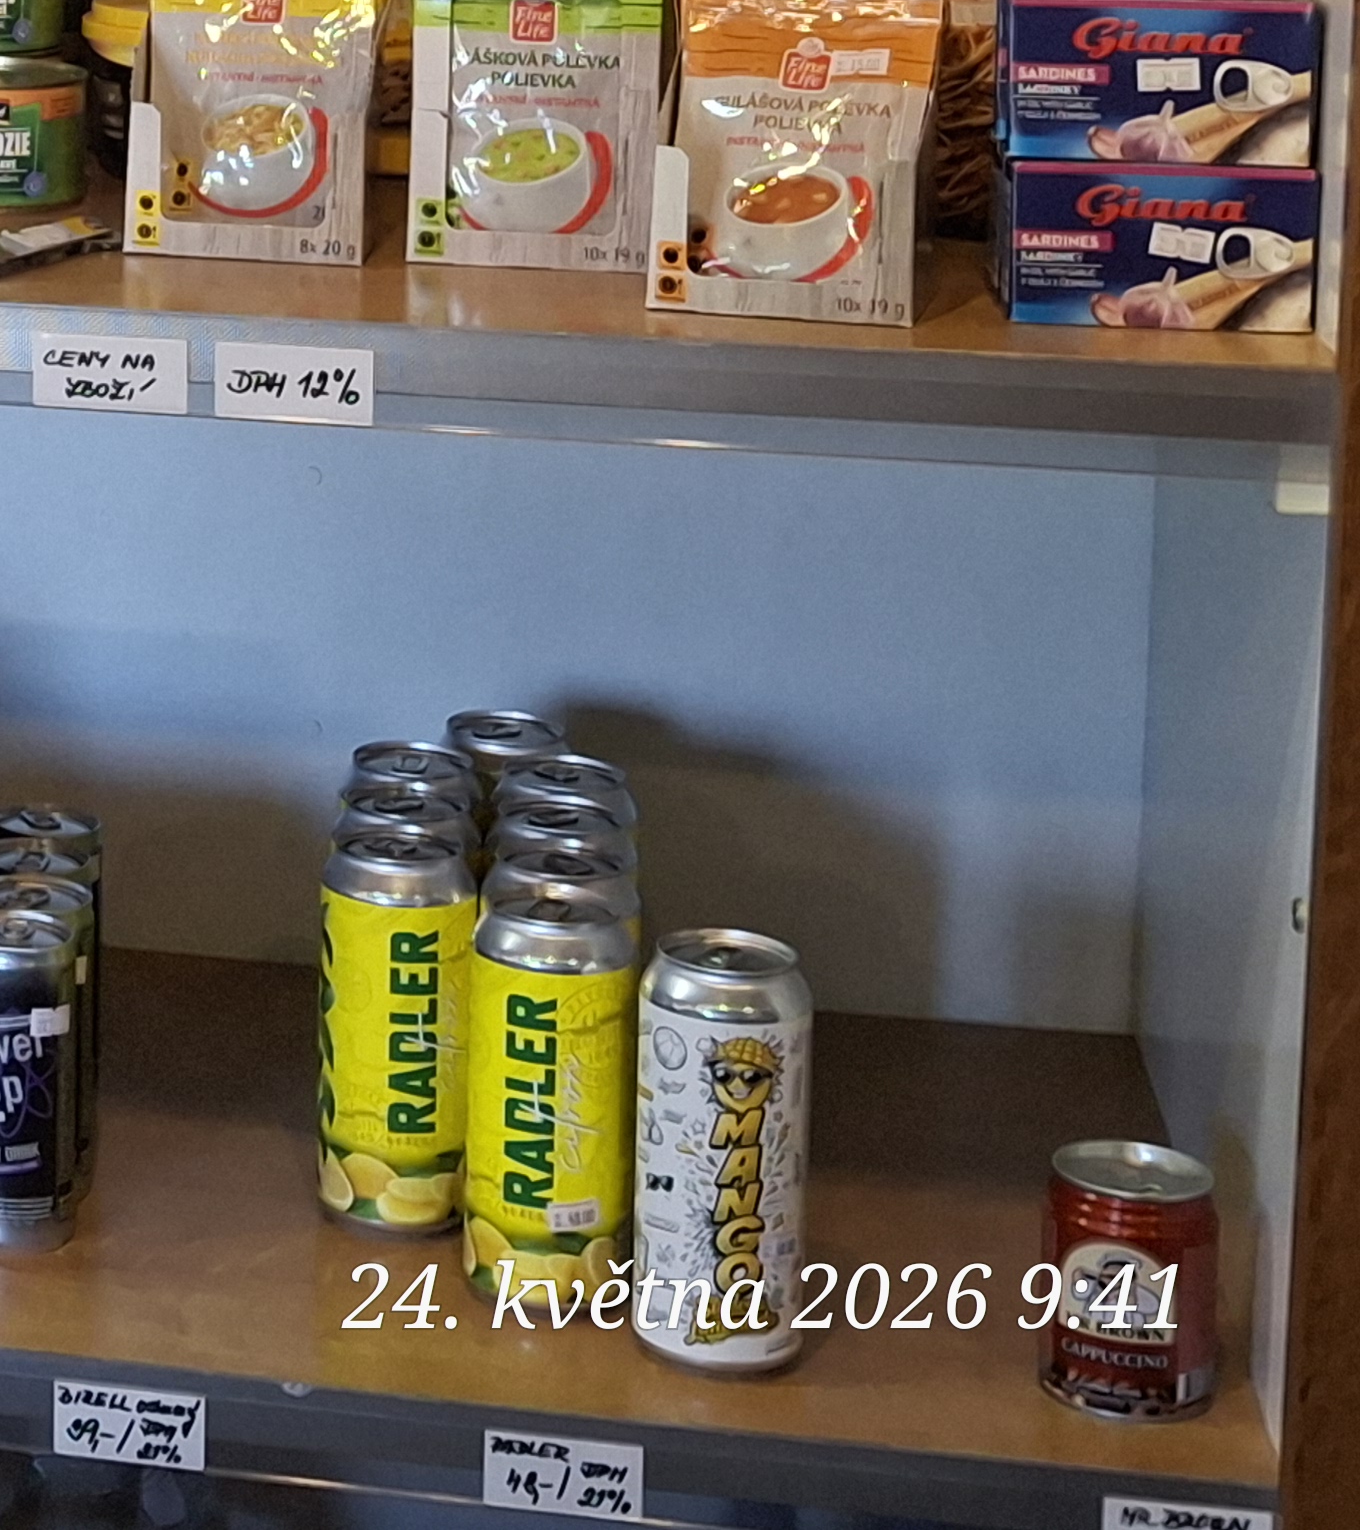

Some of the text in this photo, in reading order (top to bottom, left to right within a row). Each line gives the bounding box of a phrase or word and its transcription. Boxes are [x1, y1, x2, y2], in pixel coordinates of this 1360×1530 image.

[515, 5, 555, 24] Fine
[516, 21, 553, 39] Life
[1071, 16, 1246, 60] Giana
[1017, 66, 1098, 83] SARDINES
[1075, 183, 1248, 228] Giana
[1020, 232, 1101, 249] SARDINES
[43, 346, 157, 373] CENY NA
[226, 369, 362, 407] DPH 12%
[386, 928, 442, 1138] RADLER
[502, 991, 559, 1210] RADLER
[710, 1107, 768, 1296] MANGO
[1060, 1336, 1169, 1369] CAPPUCCINO
